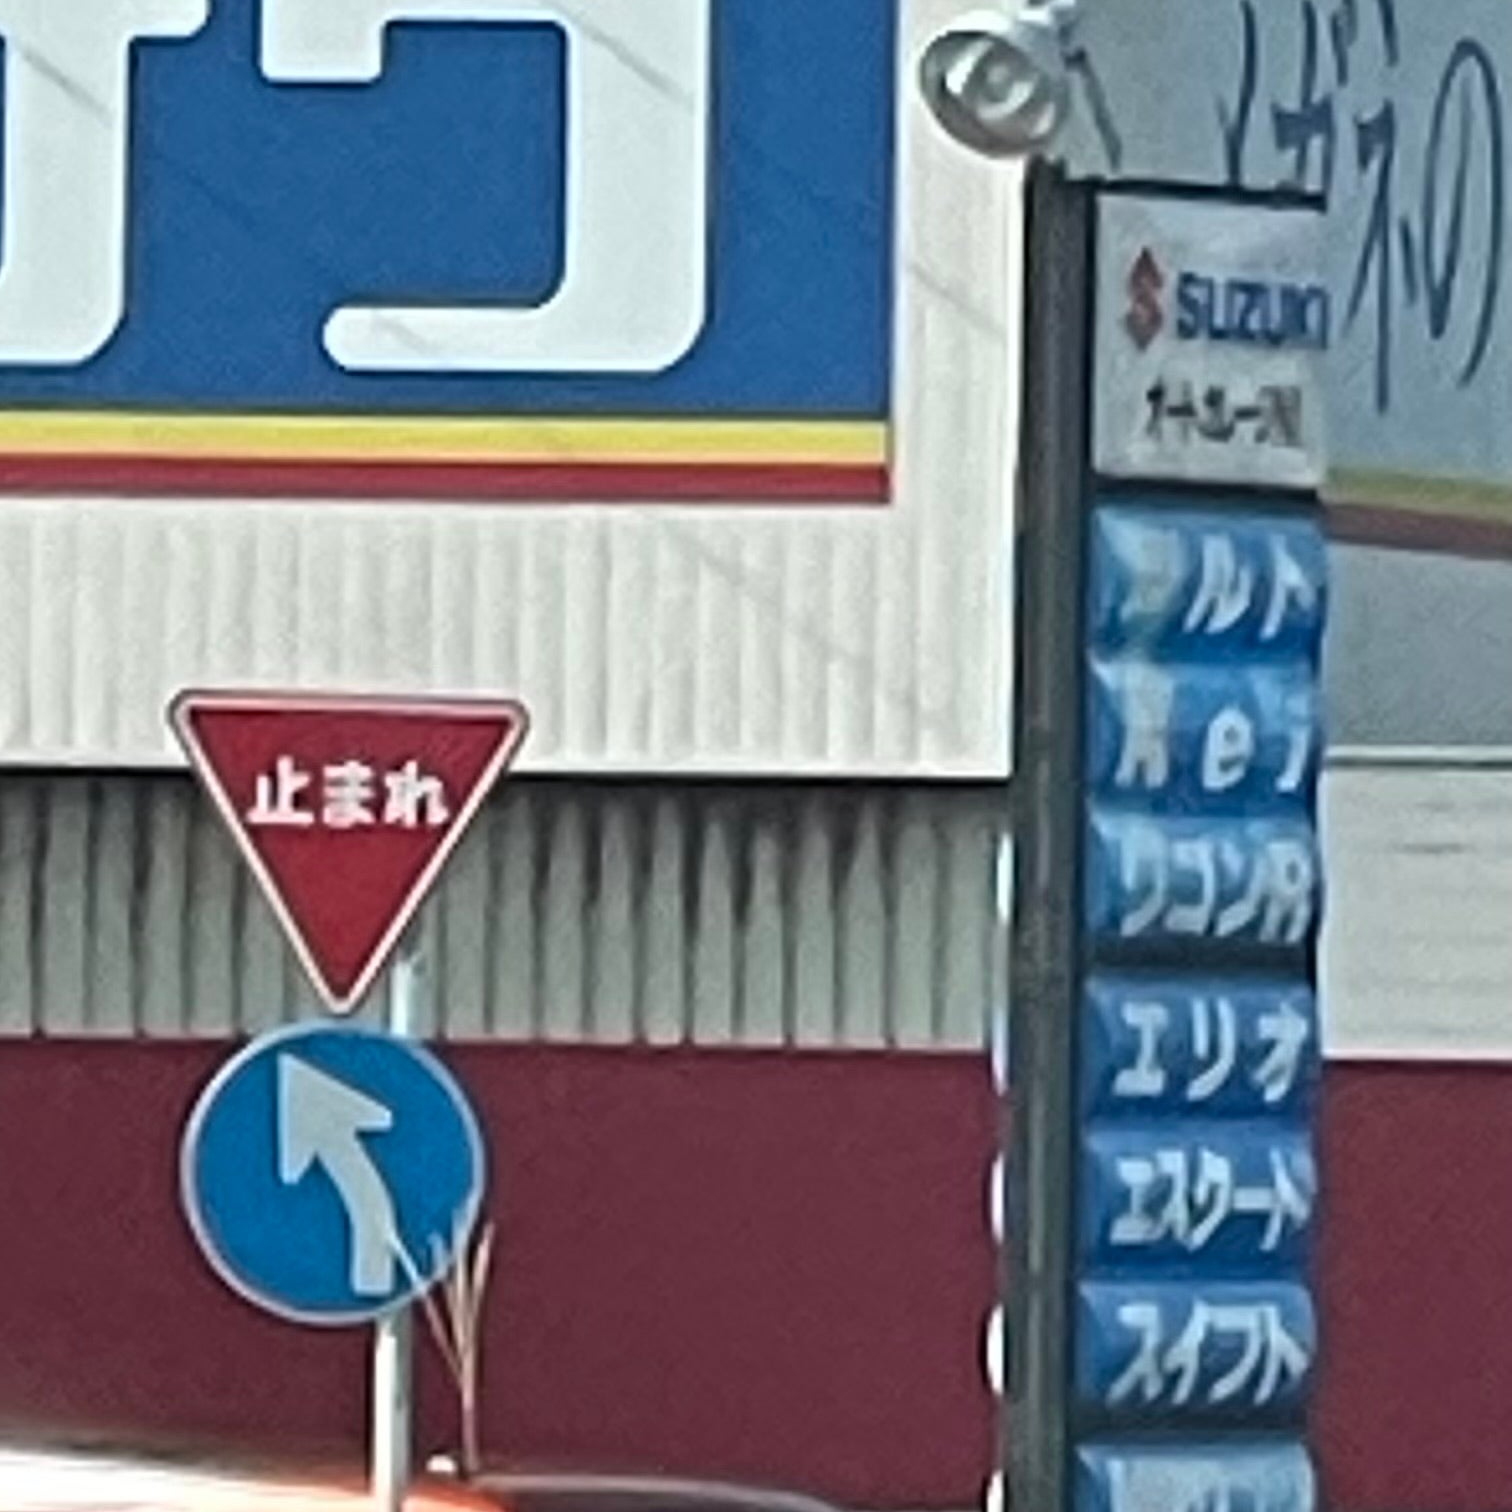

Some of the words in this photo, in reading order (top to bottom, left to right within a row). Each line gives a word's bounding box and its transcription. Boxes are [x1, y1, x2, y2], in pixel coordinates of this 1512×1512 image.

[246, 755, 449, 828] 止まれ
[1112, 999, 1309, 1103] エリオ
[1105, 1300, 1310, 1405] スイフト
